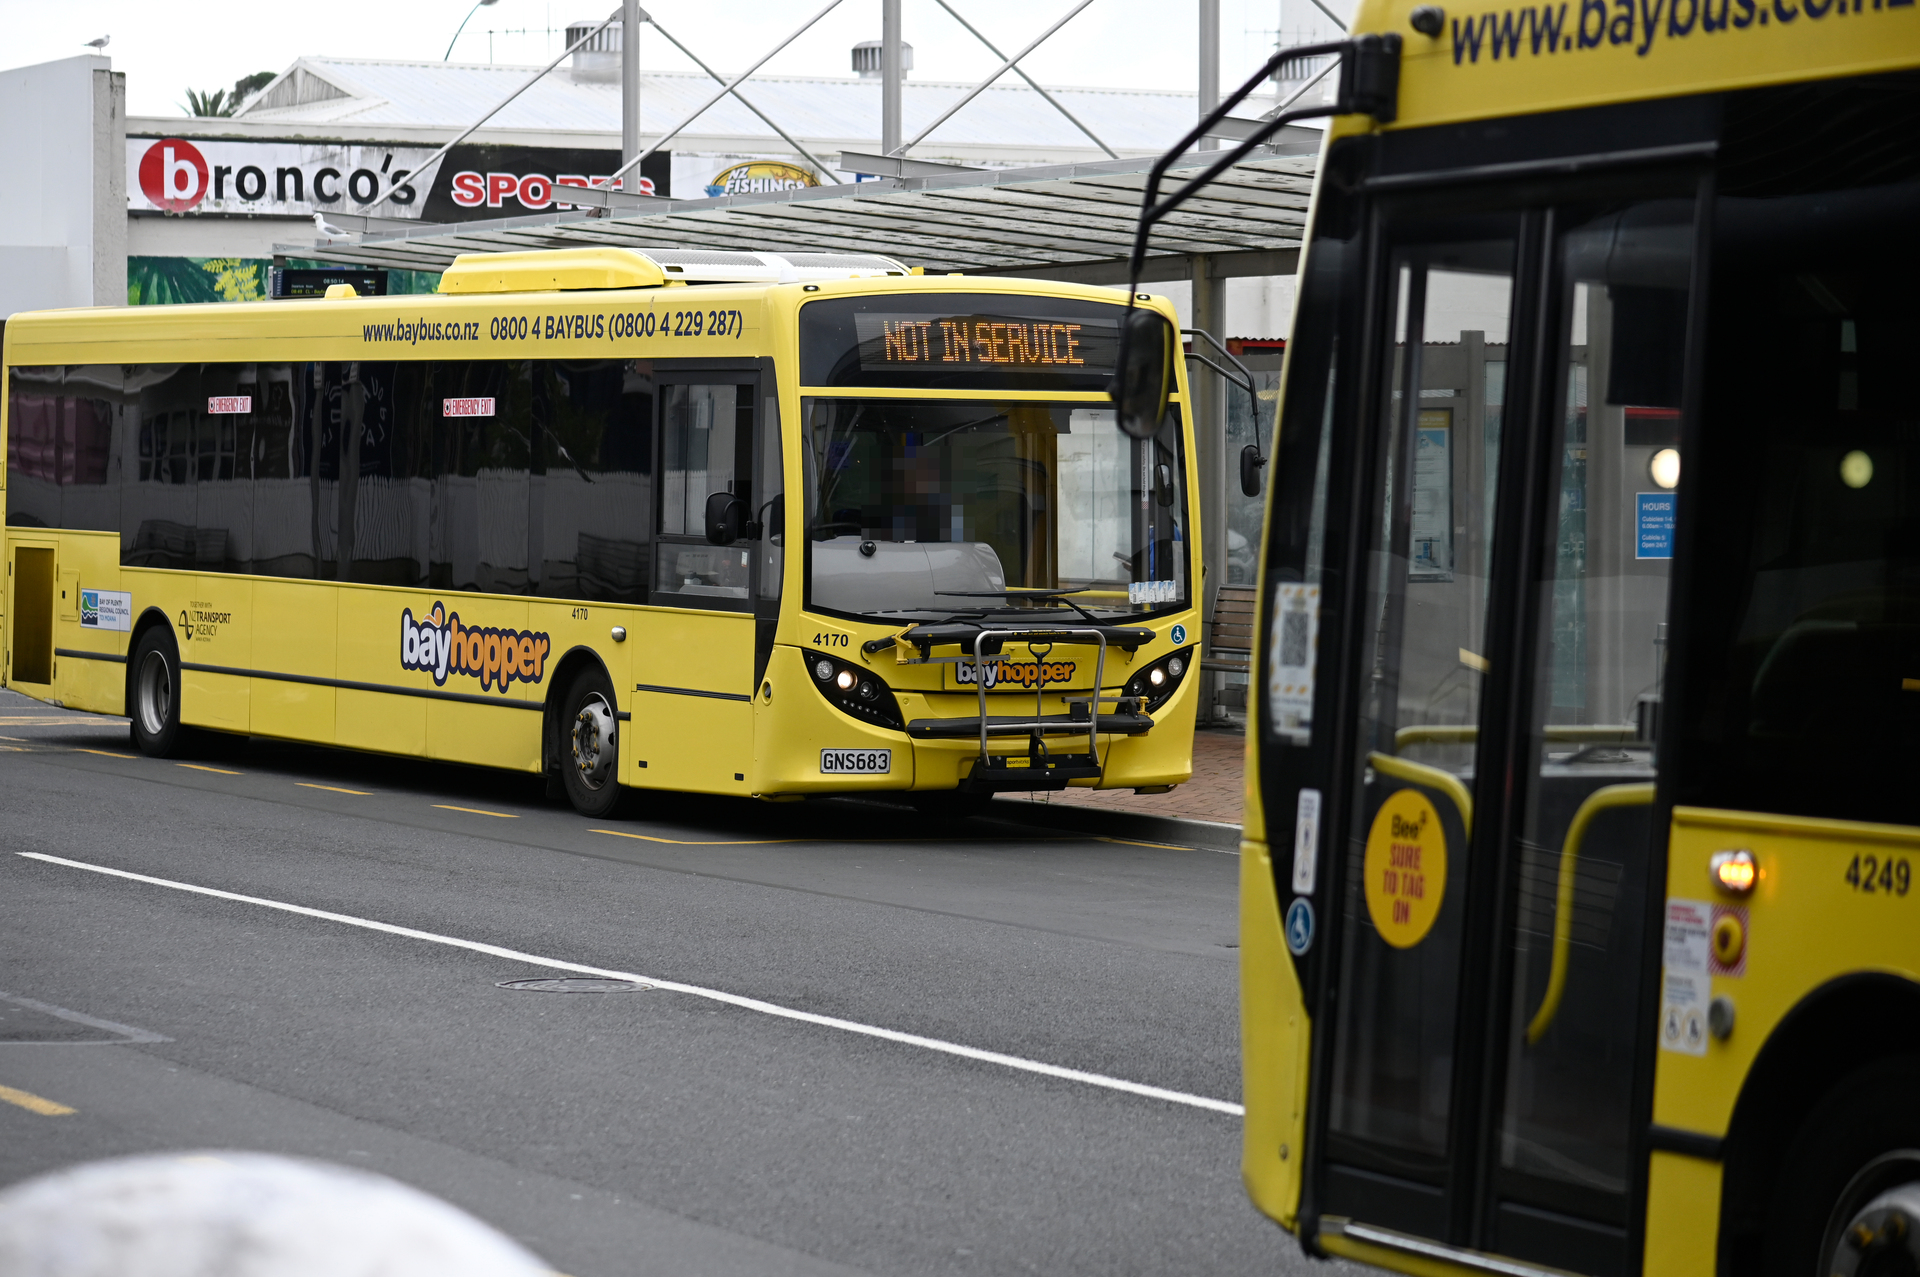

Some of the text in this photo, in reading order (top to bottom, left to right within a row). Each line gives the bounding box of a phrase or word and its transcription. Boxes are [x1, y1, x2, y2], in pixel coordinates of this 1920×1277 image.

[163, 146, 417, 205] bronco's
[728, 167, 750, 181] NZ
[363, 310, 743, 346] www.baybus.co.nz 0800 4 BAYBUS (0800 4 229 287)
[883, 320, 1084, 364] NOT IN SERVICE
[216, 397, 249, 412] EMERGENCY EXIT
[452, 399, 492, 415] EMERGENCY EXIT
[1642, 502, 1671, 511] HOURS
[571, 608, 588, 621] 4170
[195, 623, 218, 636] AGENCY
[812, 633, 849, 647] 4170
[402, 611, 549, 690] bayhopper
[823, 752, 888, 770] GNS683
[1390, 843, 1422, 870] SURE
[1383, 869, 1425, 899] TO TAG
[1845, 854, 1911, 898] 4249
[1393, 899, 1411, 925] ON
